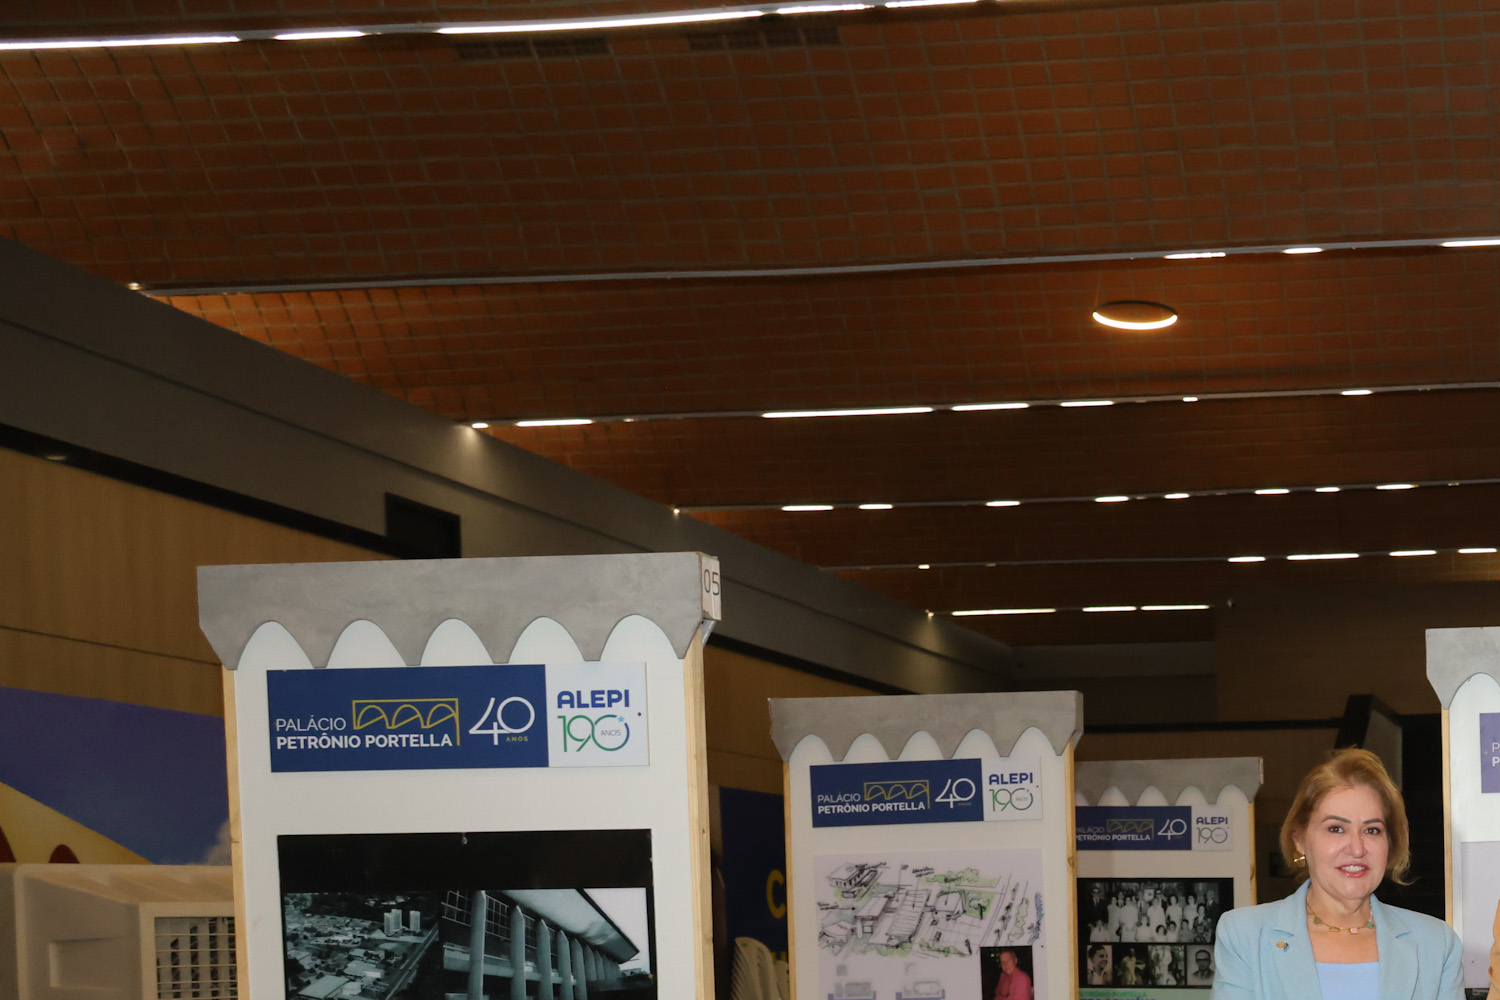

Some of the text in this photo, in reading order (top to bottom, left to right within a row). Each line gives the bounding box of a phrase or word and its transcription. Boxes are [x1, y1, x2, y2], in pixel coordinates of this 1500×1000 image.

[558, 690, 629, 708] ALEPI
[276, 713, 346, 732] PALÁCIO
[468, 697, 535, 745] 40
[277, 732, 452, 750] PETRÔNIO PORTELLA
[558, 714, 630, 752] 190
[989, 772, 1033, 785] ALEPI
[818, 792, 860, 803] PALÁCIO
[934, 778, 976, 808] 40
[989, 788, 1033, 812] 190
[818, 802, 926, 814] PETRÔNIO PORTELLA
[1158, 819, 1187, 840] 40
[1196, 816, 1228, 825] ALEPI
